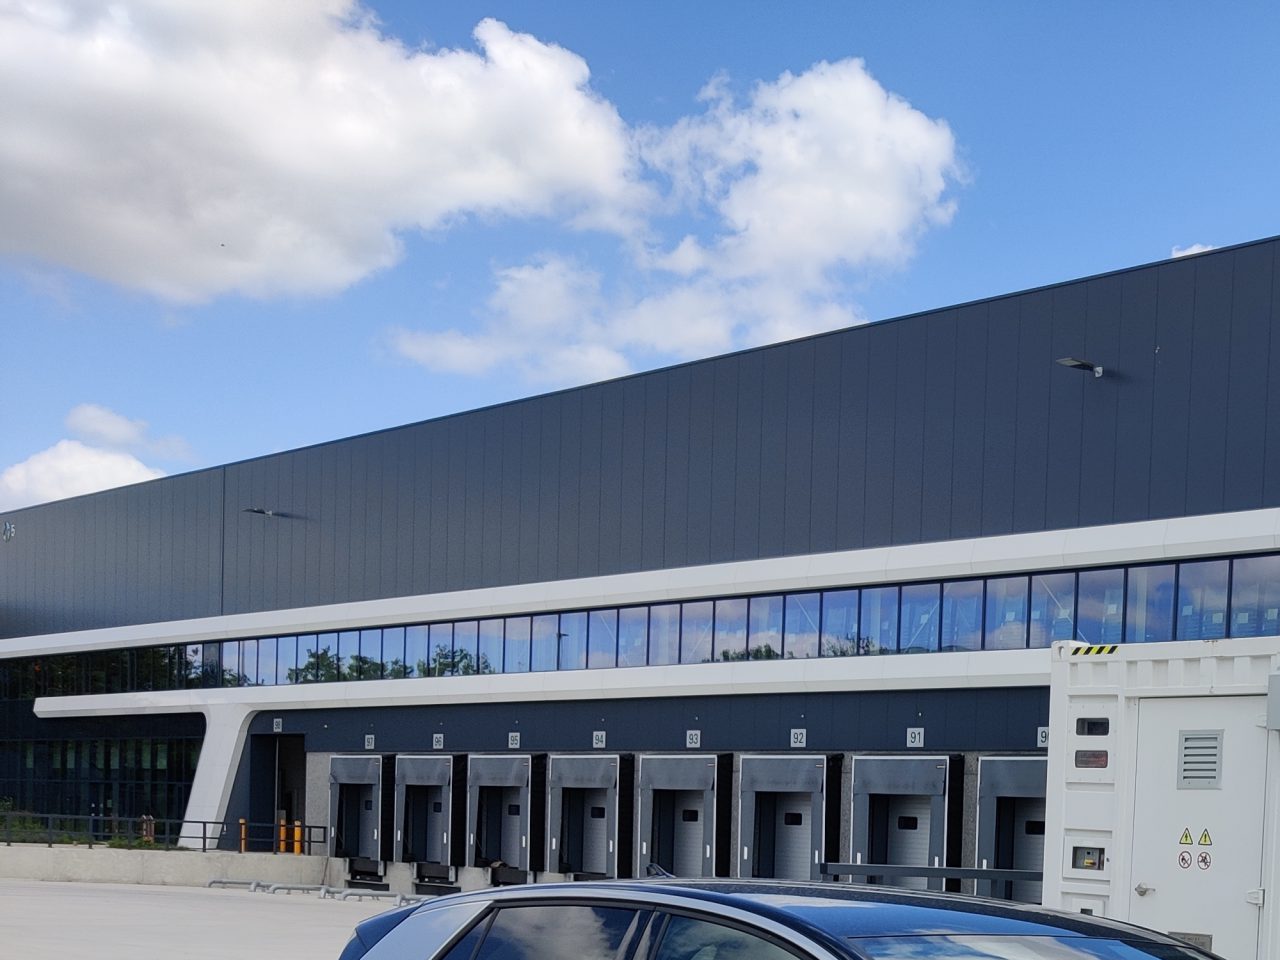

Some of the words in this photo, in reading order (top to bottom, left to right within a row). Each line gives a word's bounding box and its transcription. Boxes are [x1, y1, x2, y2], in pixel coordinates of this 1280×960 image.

[594, 734, 604, 745] 94
[688, 733, 699, 745] 93
[793, 732, 804, 744] 92
[910, 731, 921, 744] 91
